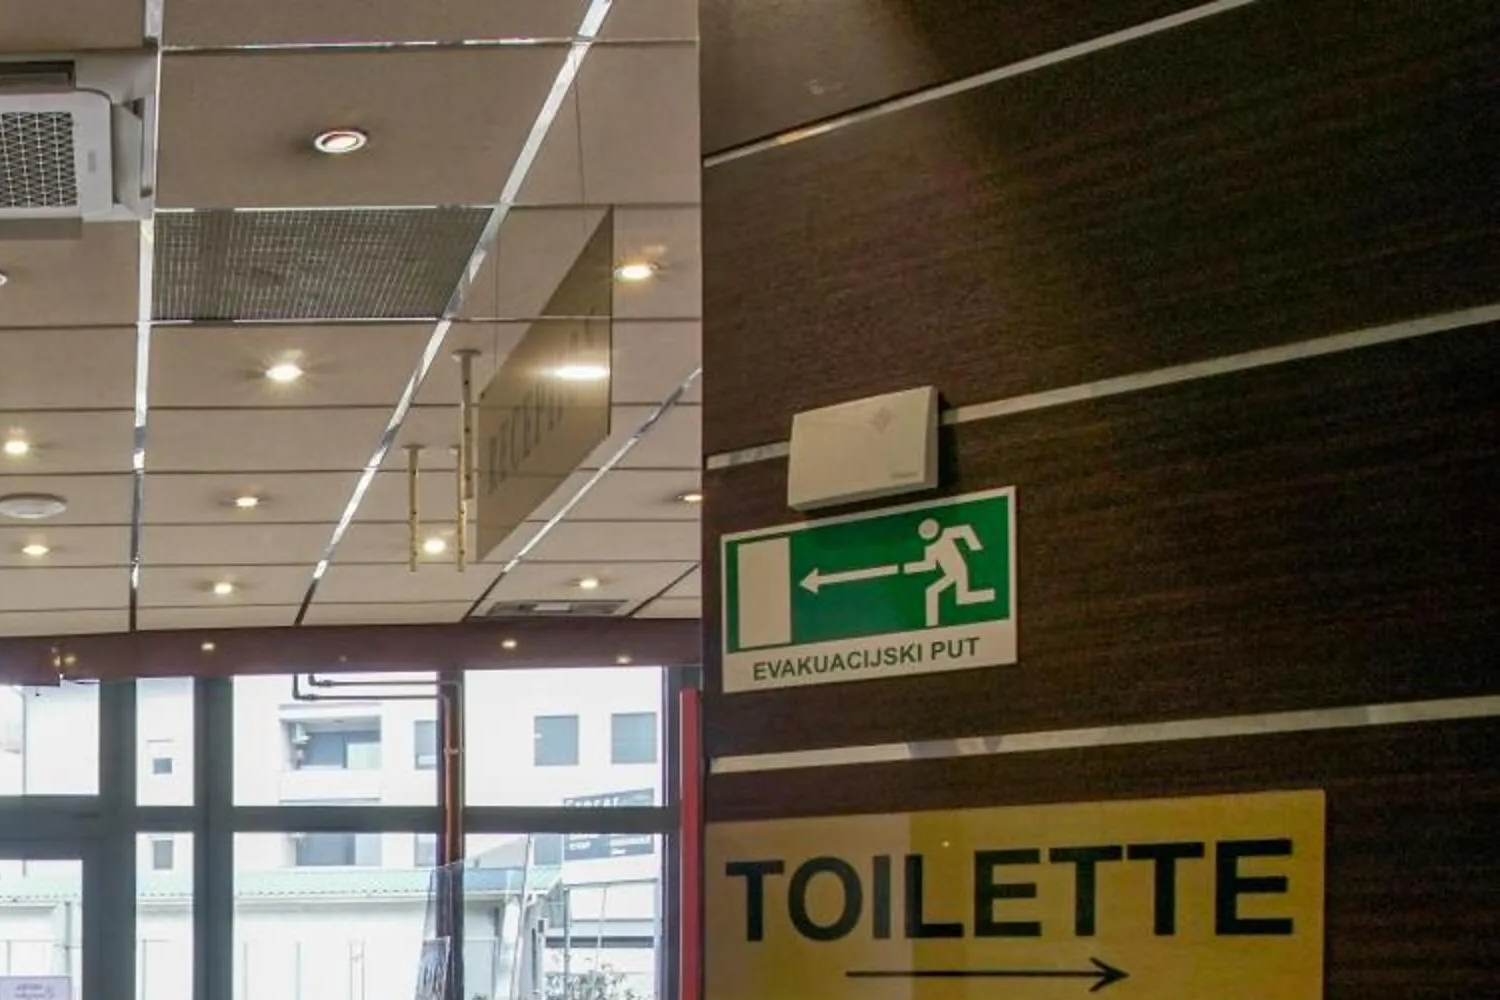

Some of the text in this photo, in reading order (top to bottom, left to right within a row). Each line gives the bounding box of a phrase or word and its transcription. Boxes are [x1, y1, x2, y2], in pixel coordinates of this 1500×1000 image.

[753, 637, 980, 681] EVAKUACIJSKI PUT
[725, 838, 1295, 942] TOILETTE
